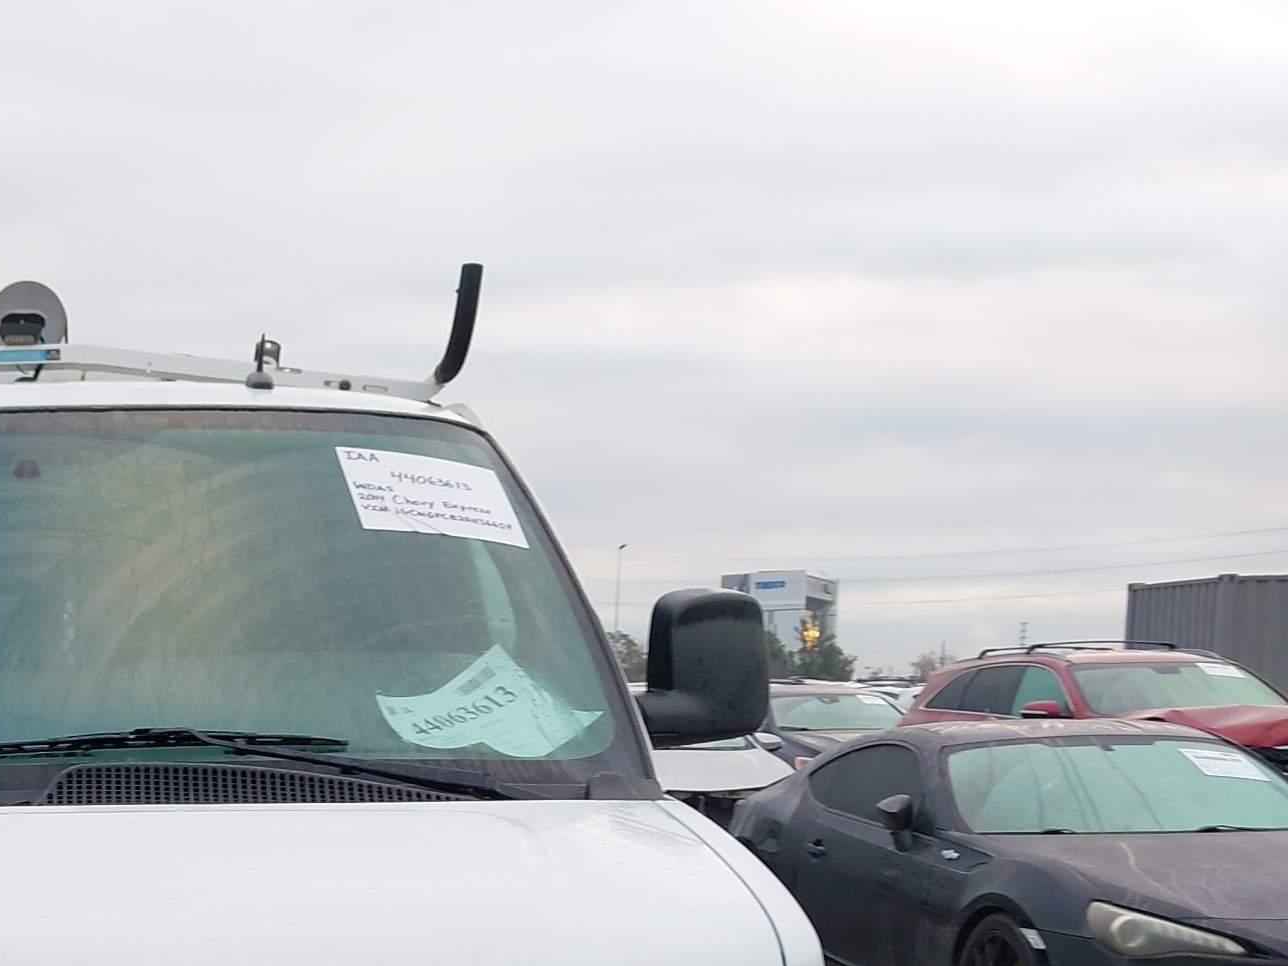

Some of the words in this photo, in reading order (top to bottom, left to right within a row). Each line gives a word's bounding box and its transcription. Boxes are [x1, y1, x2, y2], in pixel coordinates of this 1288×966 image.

[345, 451, 380, 462] IAA
[390, 471, 472, 491] 44063613
[413, 686, 518, 735] 44063613
